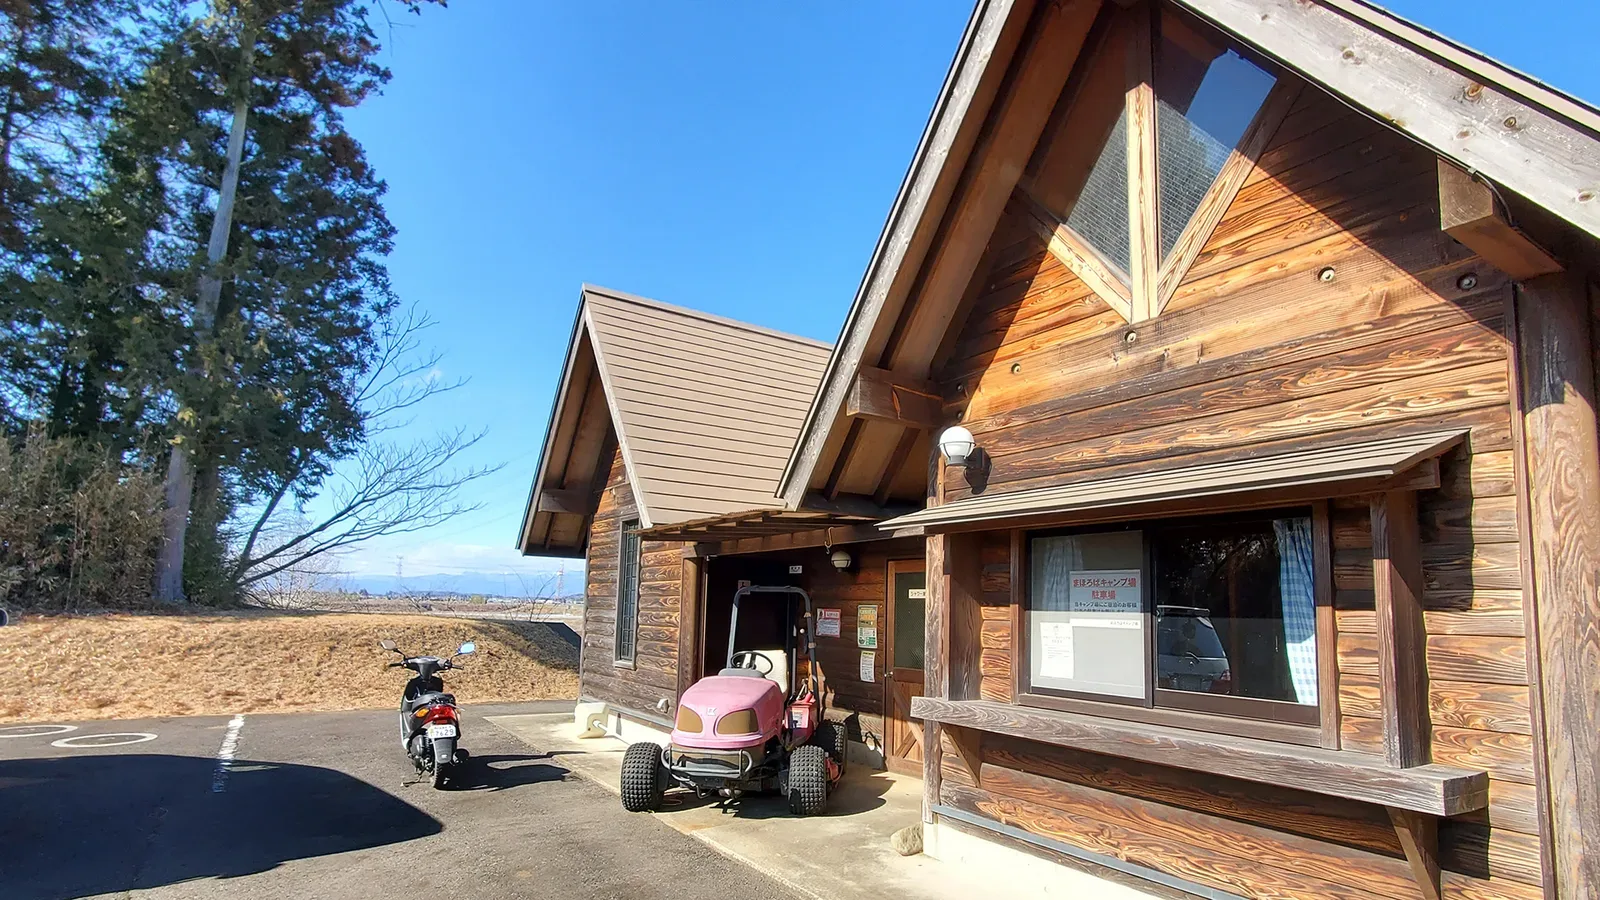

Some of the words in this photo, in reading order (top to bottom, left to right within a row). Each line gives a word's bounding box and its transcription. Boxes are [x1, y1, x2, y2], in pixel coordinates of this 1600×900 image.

[1073, 578, 1136, 588] まほろばキャンプ場
[1092, 590, 1116, 600] 駐車場
